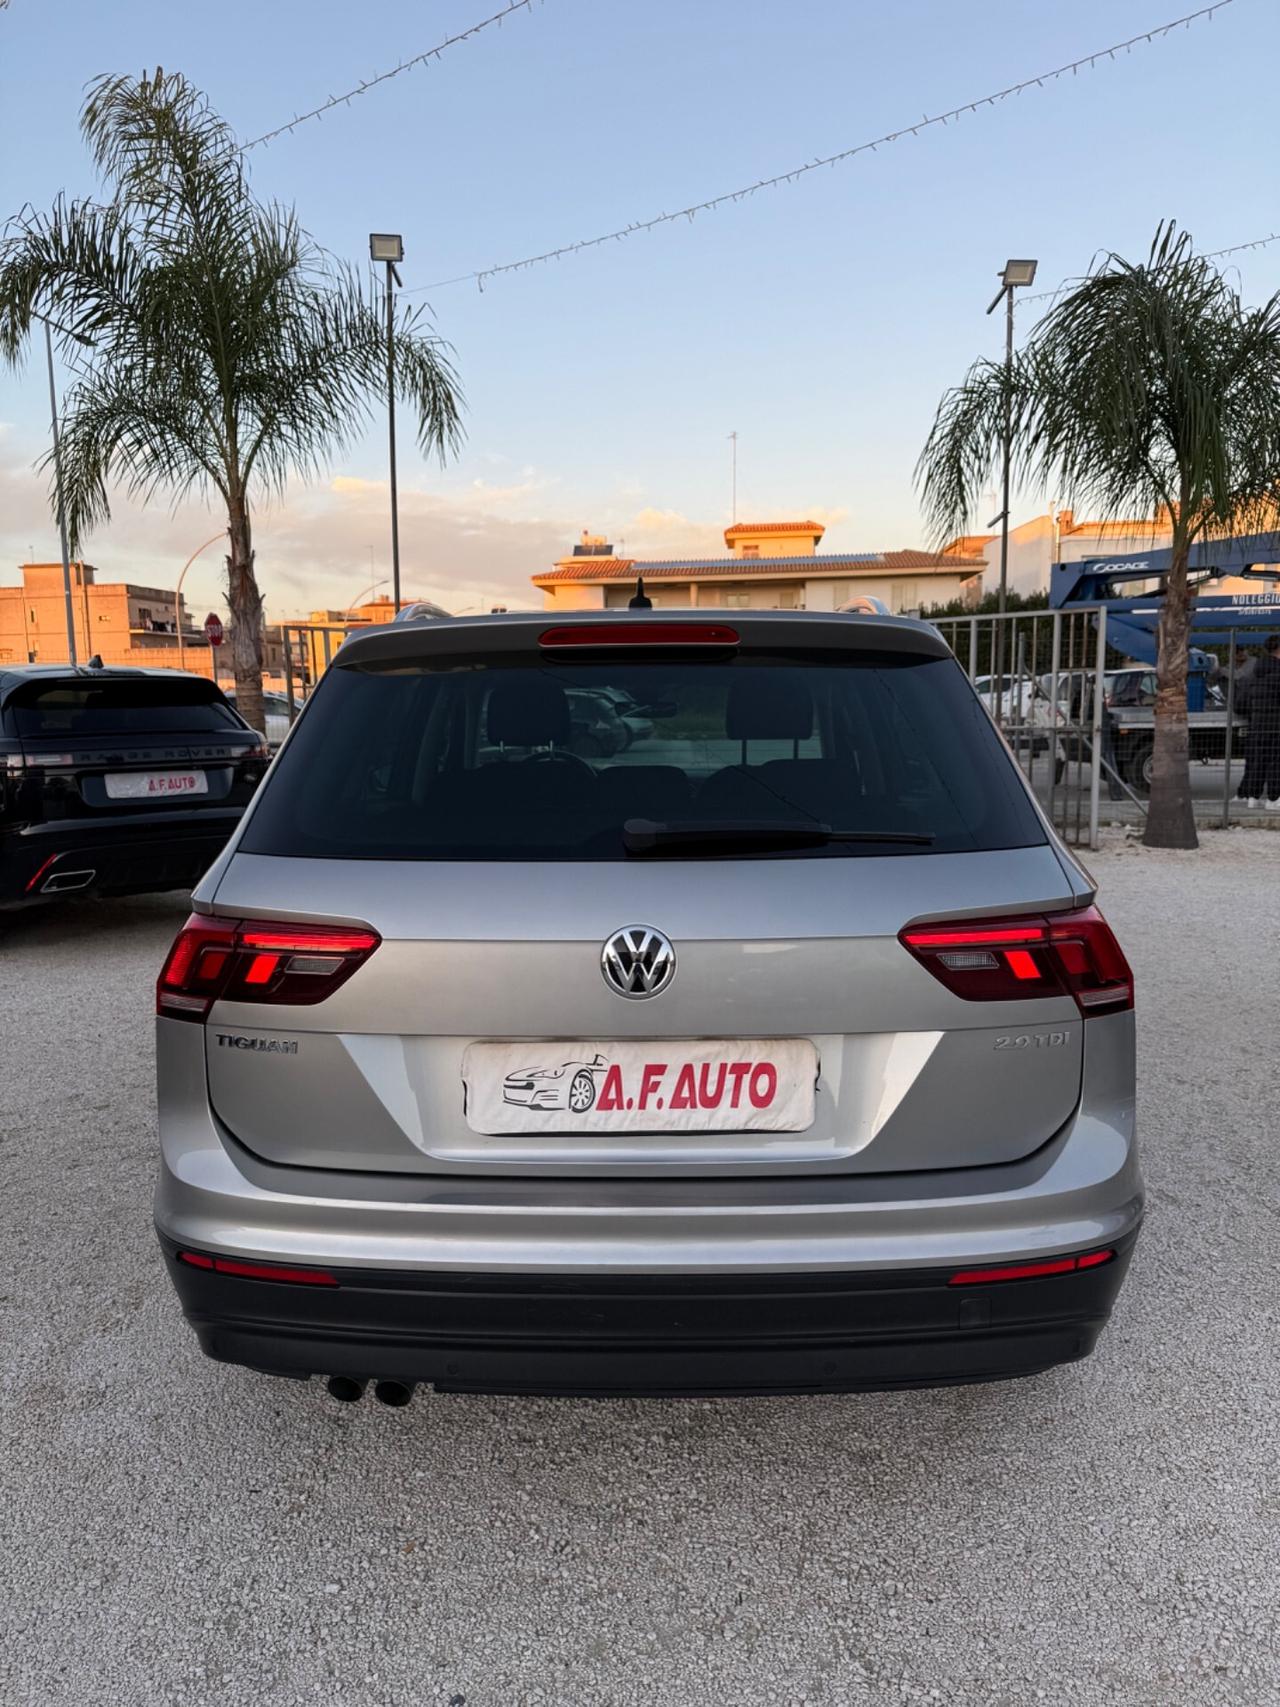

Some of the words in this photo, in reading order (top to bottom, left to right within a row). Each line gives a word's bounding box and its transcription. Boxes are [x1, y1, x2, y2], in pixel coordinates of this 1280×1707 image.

[164, 748, 225, 759] ROVER
[215, 1033, 298, 1055] TIGUAN
[1033, 1031, 1070, 1049] TDI
